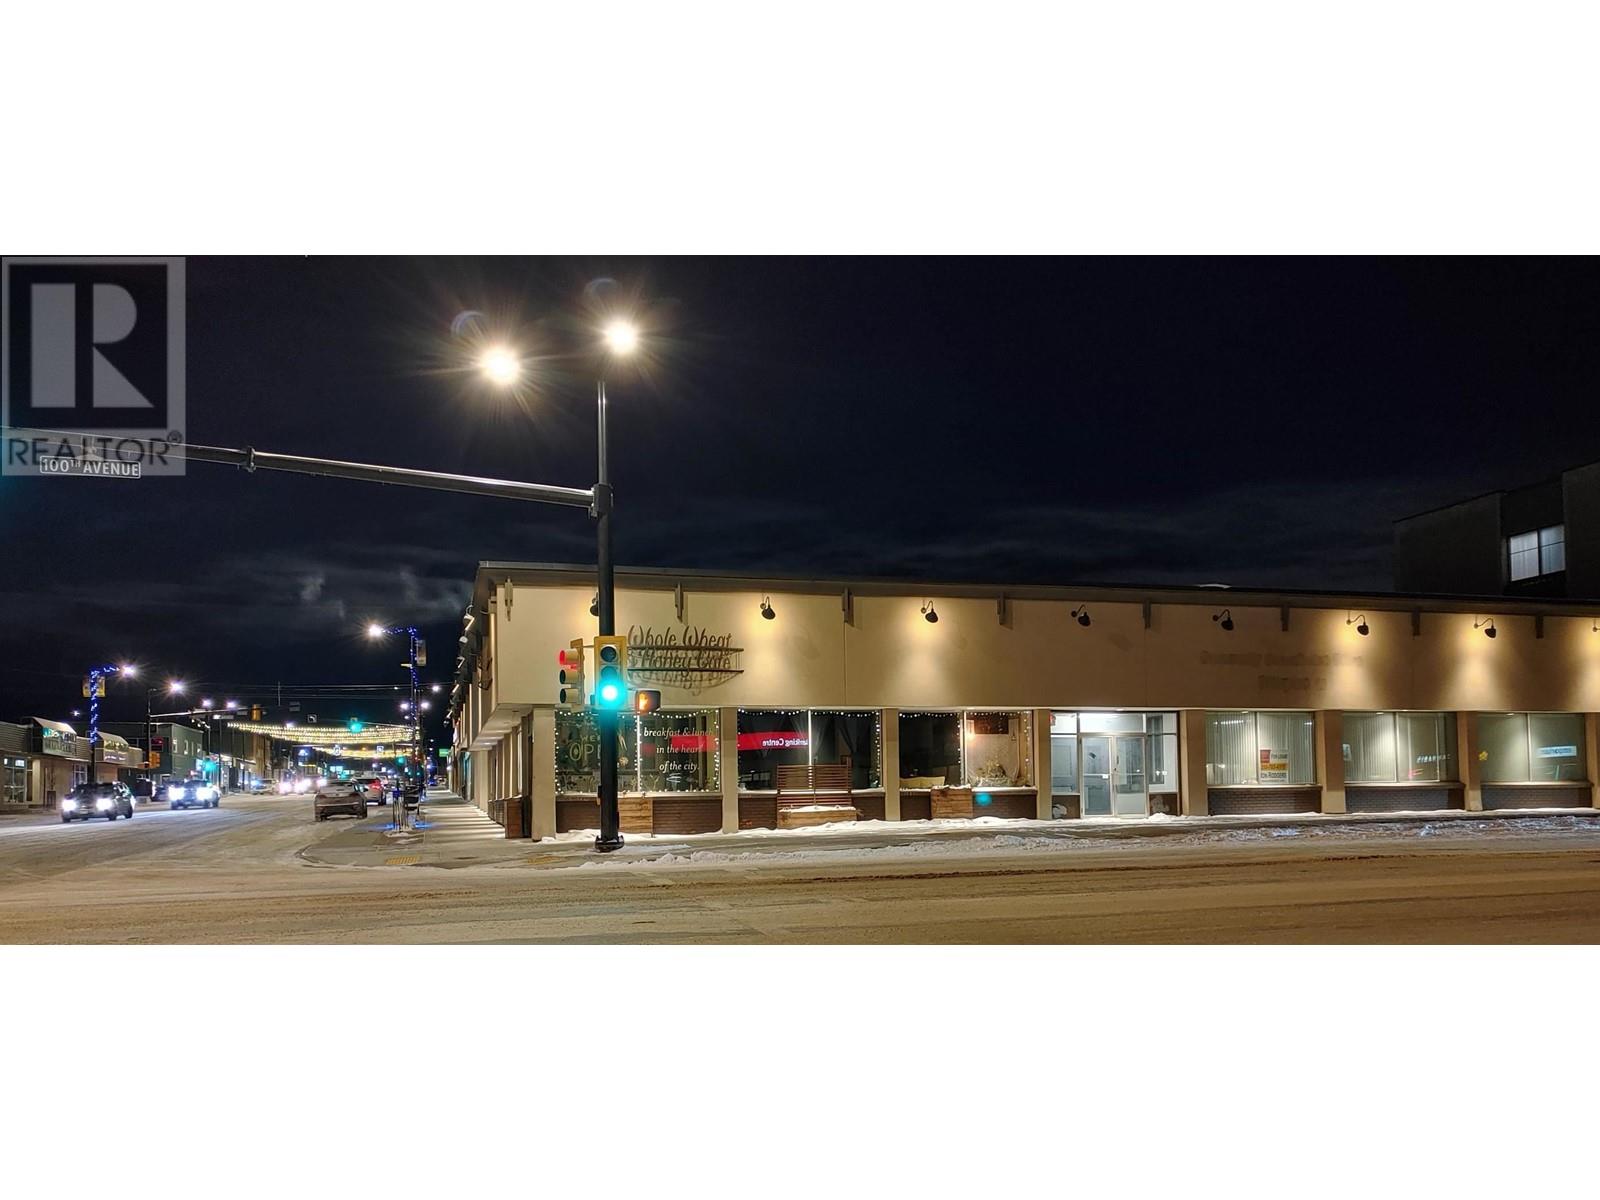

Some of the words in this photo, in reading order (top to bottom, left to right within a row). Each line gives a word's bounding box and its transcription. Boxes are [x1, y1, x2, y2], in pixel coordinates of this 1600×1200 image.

[82, 461, 139, 476] AVENUE
[627, 625, 677, 647] Whole
[683, 625, 732, 648] Wheat
[643, 726, 681, 740] breakfast
[656, 745, 665, 754] in
[666, 743, 679, 754] the
[659, 760, 670, 773] of
[669, 760, 682, 771] the
